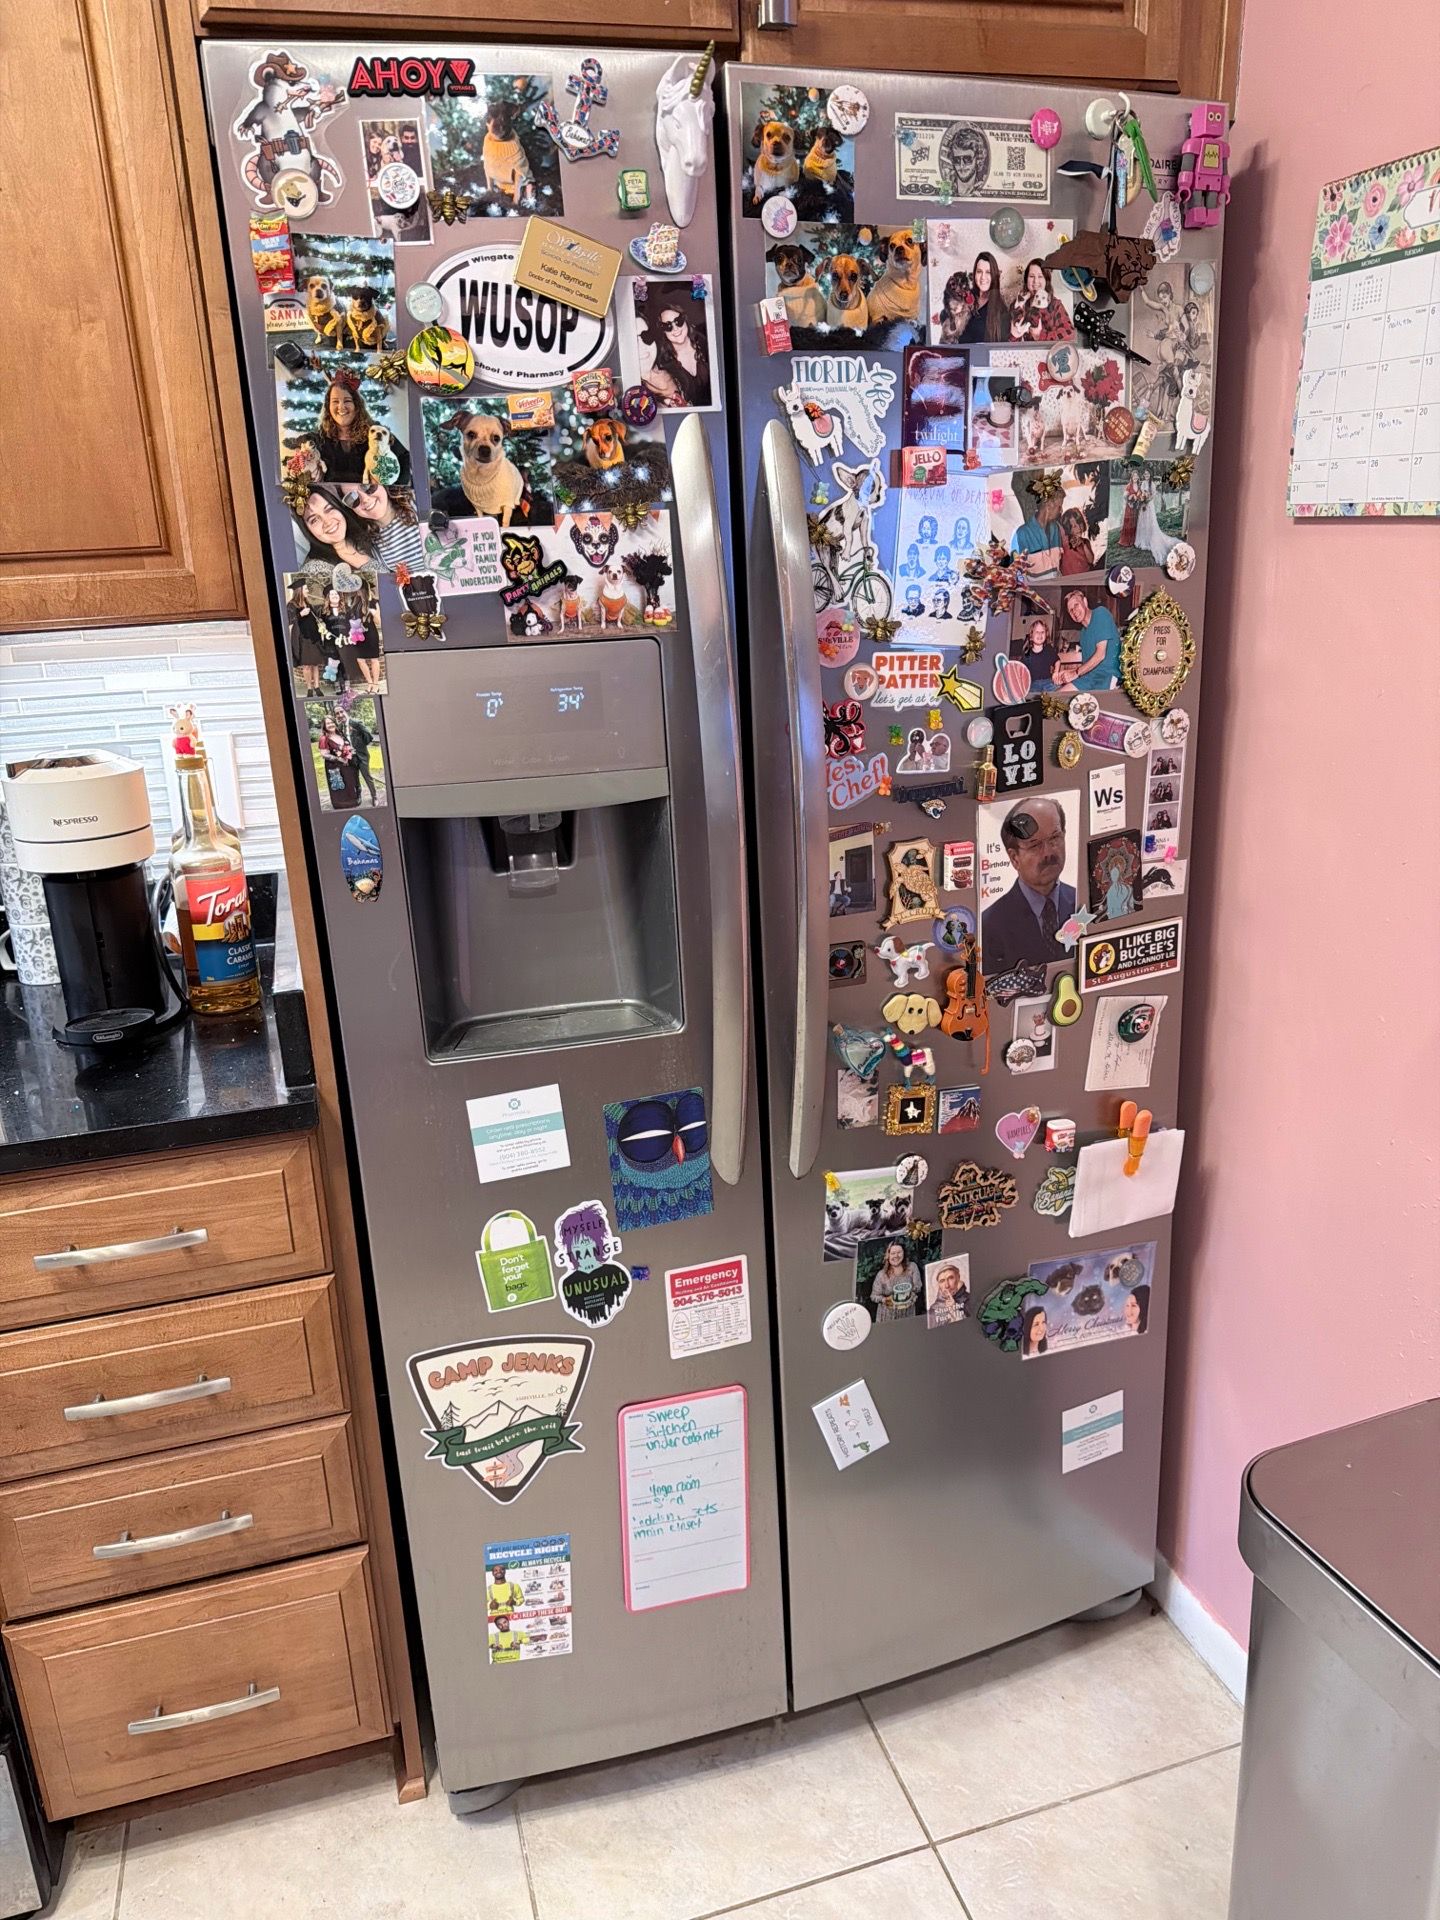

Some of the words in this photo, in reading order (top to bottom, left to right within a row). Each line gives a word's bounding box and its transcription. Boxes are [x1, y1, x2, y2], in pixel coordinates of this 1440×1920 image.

[350, 59, 444, 90] AHOY
[472, 254, 514, 264] Wingate
[1323, 268, 1340, 276] SUNDAY
[1361, 258, 1382, 267] MONDAY
[1404, 248, 1425, 256] TUESDAY
[540, 262, 558, 276] Katie
[560, 270, 593, 290] Raymond
[528, 271, 544, 281] Doctor
[550, 280, 575, 295] Pharmacy
[575, 290, 598, 304] Candidate
[270, 310, 305, 321] SANTA
[459, 277, 579, 355] WUSOP
[1430, 307, 1436, 315] 6
[1381, 364, 1388, 372] 12
[1425, 357, 1434, 366] 13
[474, 361, 500, 376] chool
[516, 370, 564, 379] Pharmacy
[1304, 374, 1310, 382] 10
[1376, 412, 1384, 420] 19
[1419, 408, 1428, 416] 20
[1298, 420, 1305, 428] 17
[1336, 416, 1342, 424] 18
[913, 424, 958, 446] twilight
[1294, 463, 1300, 471] 24
[1330, 462, 1338, 470] 25
[1370, 460, 1378, 468] 26
[1414, 457, 1422, 465] 27
[472, 532, 478, 542] IF
[480, 532, 494, 541] YOU
[473, 544, 488, 553] MET
[489, 543, 497, 552] MY
[475, 553, 498, 564] FAMILY
[478, 564, 498, 574] YOU'D
[460, 575, 503, 587] UNDERSTAND
[530, 566, 563, 592] ANIMALS
[1154, 625, 1172, 635] PRESS
[1156, 636, 1166, 646] FOR
[875, 654, 942, 672] PITTER
[1142, 666, 1176, 676] CHAMPAGNE
[878, 674, 940, 688] PATTER
[897, 696, 913, 708] get
[914, 694, 926, 703] at
[1002, 740, 1036, 764] LO
[1003, 762, 1037, 786] VE
[832, 756, 886, 806] Chef!
[1094, 787, 1124, 808] Ws
[52, 815, 98, 827] NESPRESSO
[986, 842, 1001, 854] It's
[346, 857, 378, 866] Bahamas
[982, 859, 1010, 871] Birthday
[982, 872, 1002, 884] Time
[982, 886, 1004, 898] Kiddo
[1120, 938, 1123, 950] I
[1126, 932, 1152, 948] LIKE
[1154, 927, 1176, 942] BIG
[1120, 940, 1174, 962] BUC-EE'S
[1118, 960, 1132, 970] AND
[1136, 954, 1165, 966] CANNOT
[1166, 950, 1176, 959] LIE
[1092, 977, 1104, 986] St.
[1160, 961, 1170, 969] FL
[1006, 1126, 1032, 1140] VAMPIRES
[580, 1213, 584, 1221] I
[563, 1220, 603, 1237] MYSELF
[558, 1240, 620, 1265] STRANGE
[500, 1253, 525, 1266] Don't
[502, 1262, 530, 1274] forget
[502, 1272, 523, 1285] your
[674, 1268, 738, 1288] Emergency
[505, 1280, 530, 1292] bags.
[564, 1272, 626, 1298] UNUSUAL
[672, 1286, 742, 1308] 904-376-5013
[1047, 1323, 1082, 1338] Merry
[1085, 1316, 1124, 1330] Christmas
[428, 1356, 494, 1390] CAMP
[502, 1352, 576, 1377] JENKS
[647, 1406, 690, 1422] Sweep
[862, 1407, 874, 1426] ITSELF
[824, 1408, 838, 1434] REPEATS
[456, 1449, 472, 1458] last
[494, 1431, 520, 1446] before
[836, 1433, 850, 1458] HISTORY
[489, 1546, 532, 1560] RECYCLE
[534, 1543, 566, 1554] RIGHT
[521, 1558, 542, 1567] ALWAYS
[543, 1556, 566, 1565] RECYCLE
[522, 1610, 536, 1618] KEEP
[537, 1608, 554, 1616] THESE
